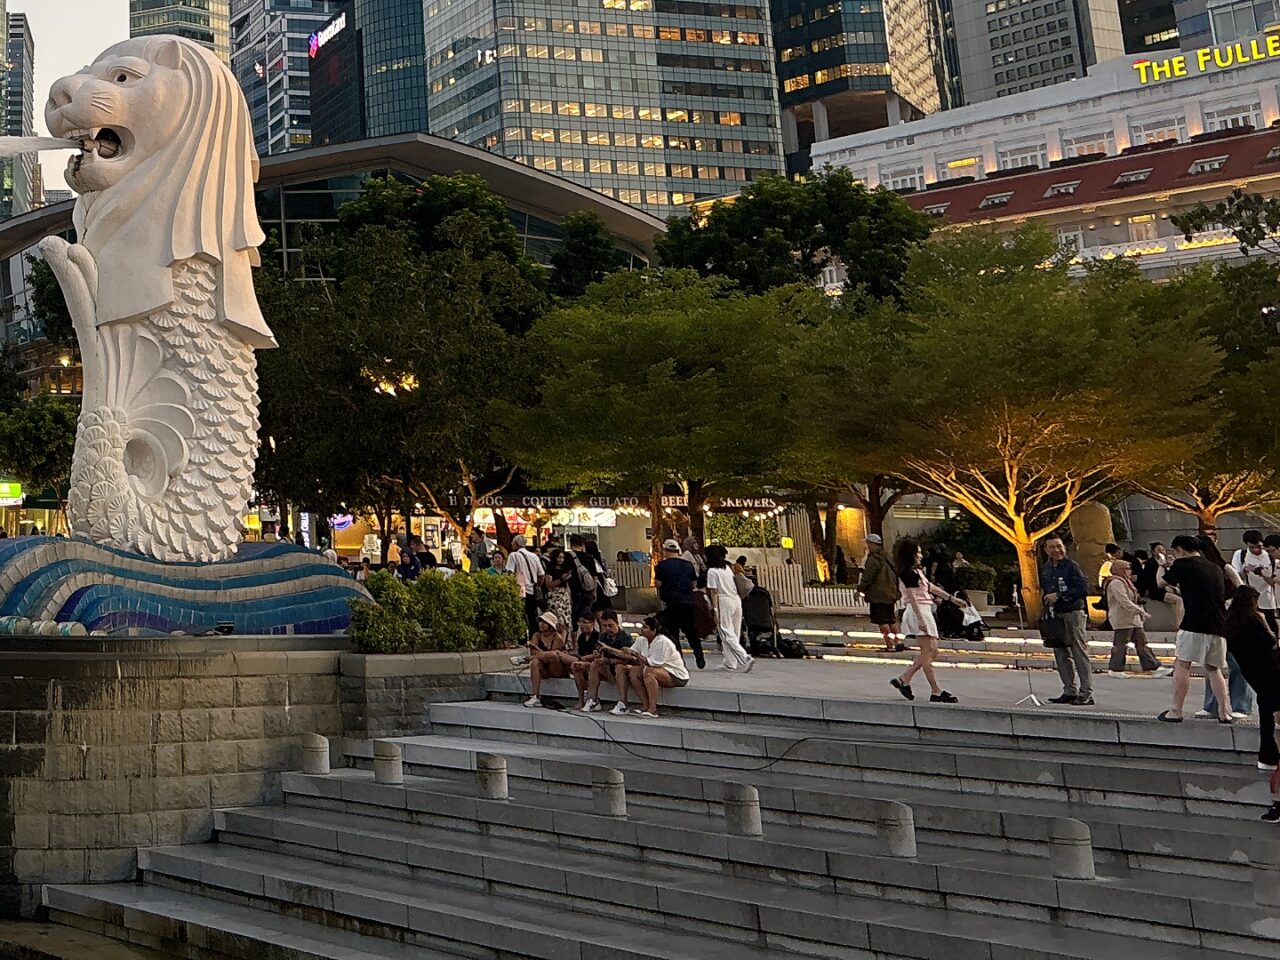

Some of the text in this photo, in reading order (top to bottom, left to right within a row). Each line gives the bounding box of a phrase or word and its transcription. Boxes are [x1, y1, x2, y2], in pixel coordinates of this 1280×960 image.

[1133, 56, 1187, 84] THE
[522, 496, 570, 506] COFFEE
[589, 496, 639, 506] GELATO
[720, 496, 776, 508] SKEWERS
